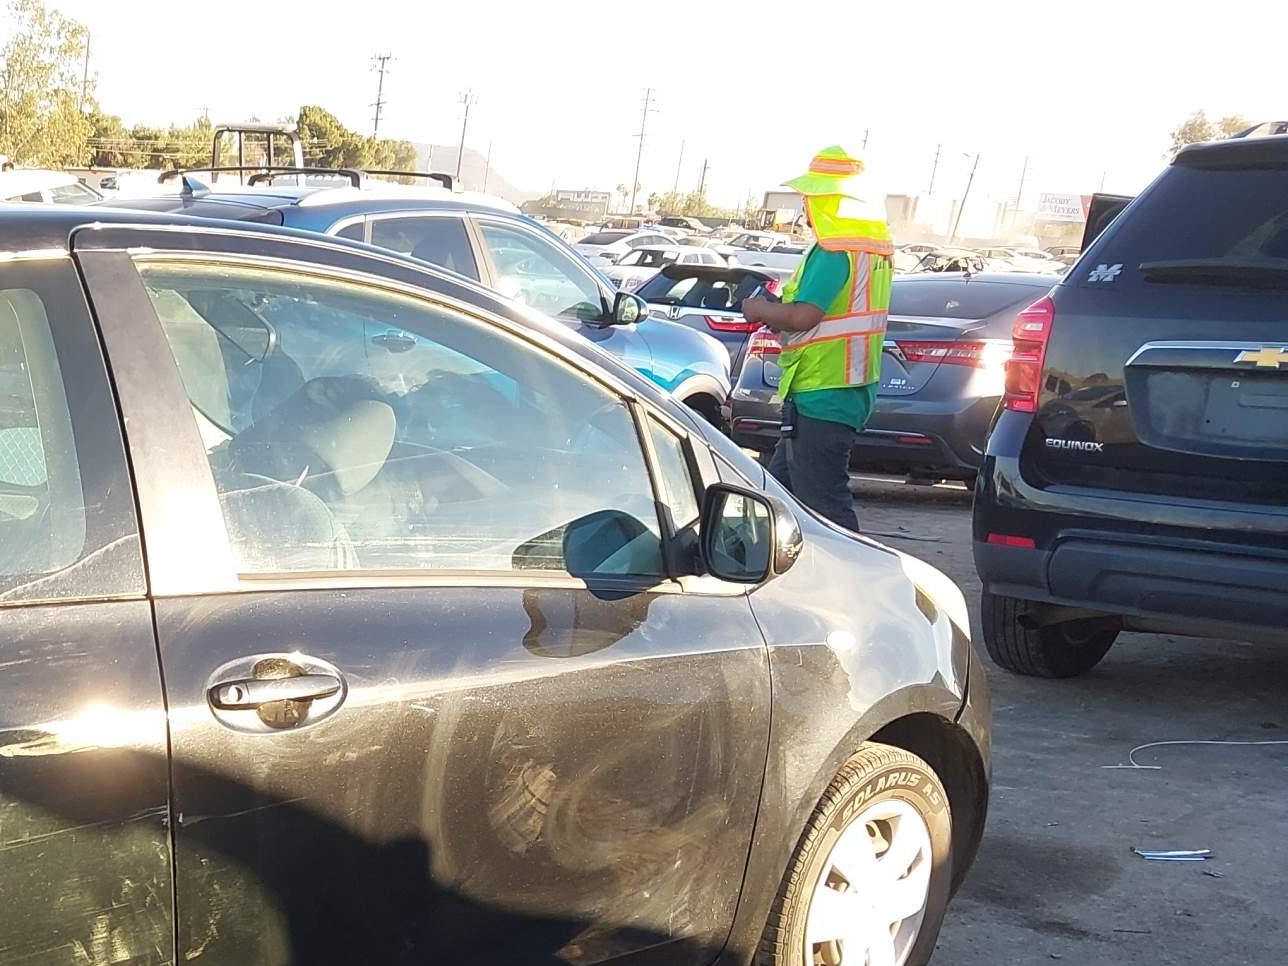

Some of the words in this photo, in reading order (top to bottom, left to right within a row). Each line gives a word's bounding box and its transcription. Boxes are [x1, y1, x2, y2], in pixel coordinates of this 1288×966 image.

[1045, 438, 1104, 452] EQUINOX
[842, 772, 921, 822] SOLARUS
[923, 783, 942, 806] AS
